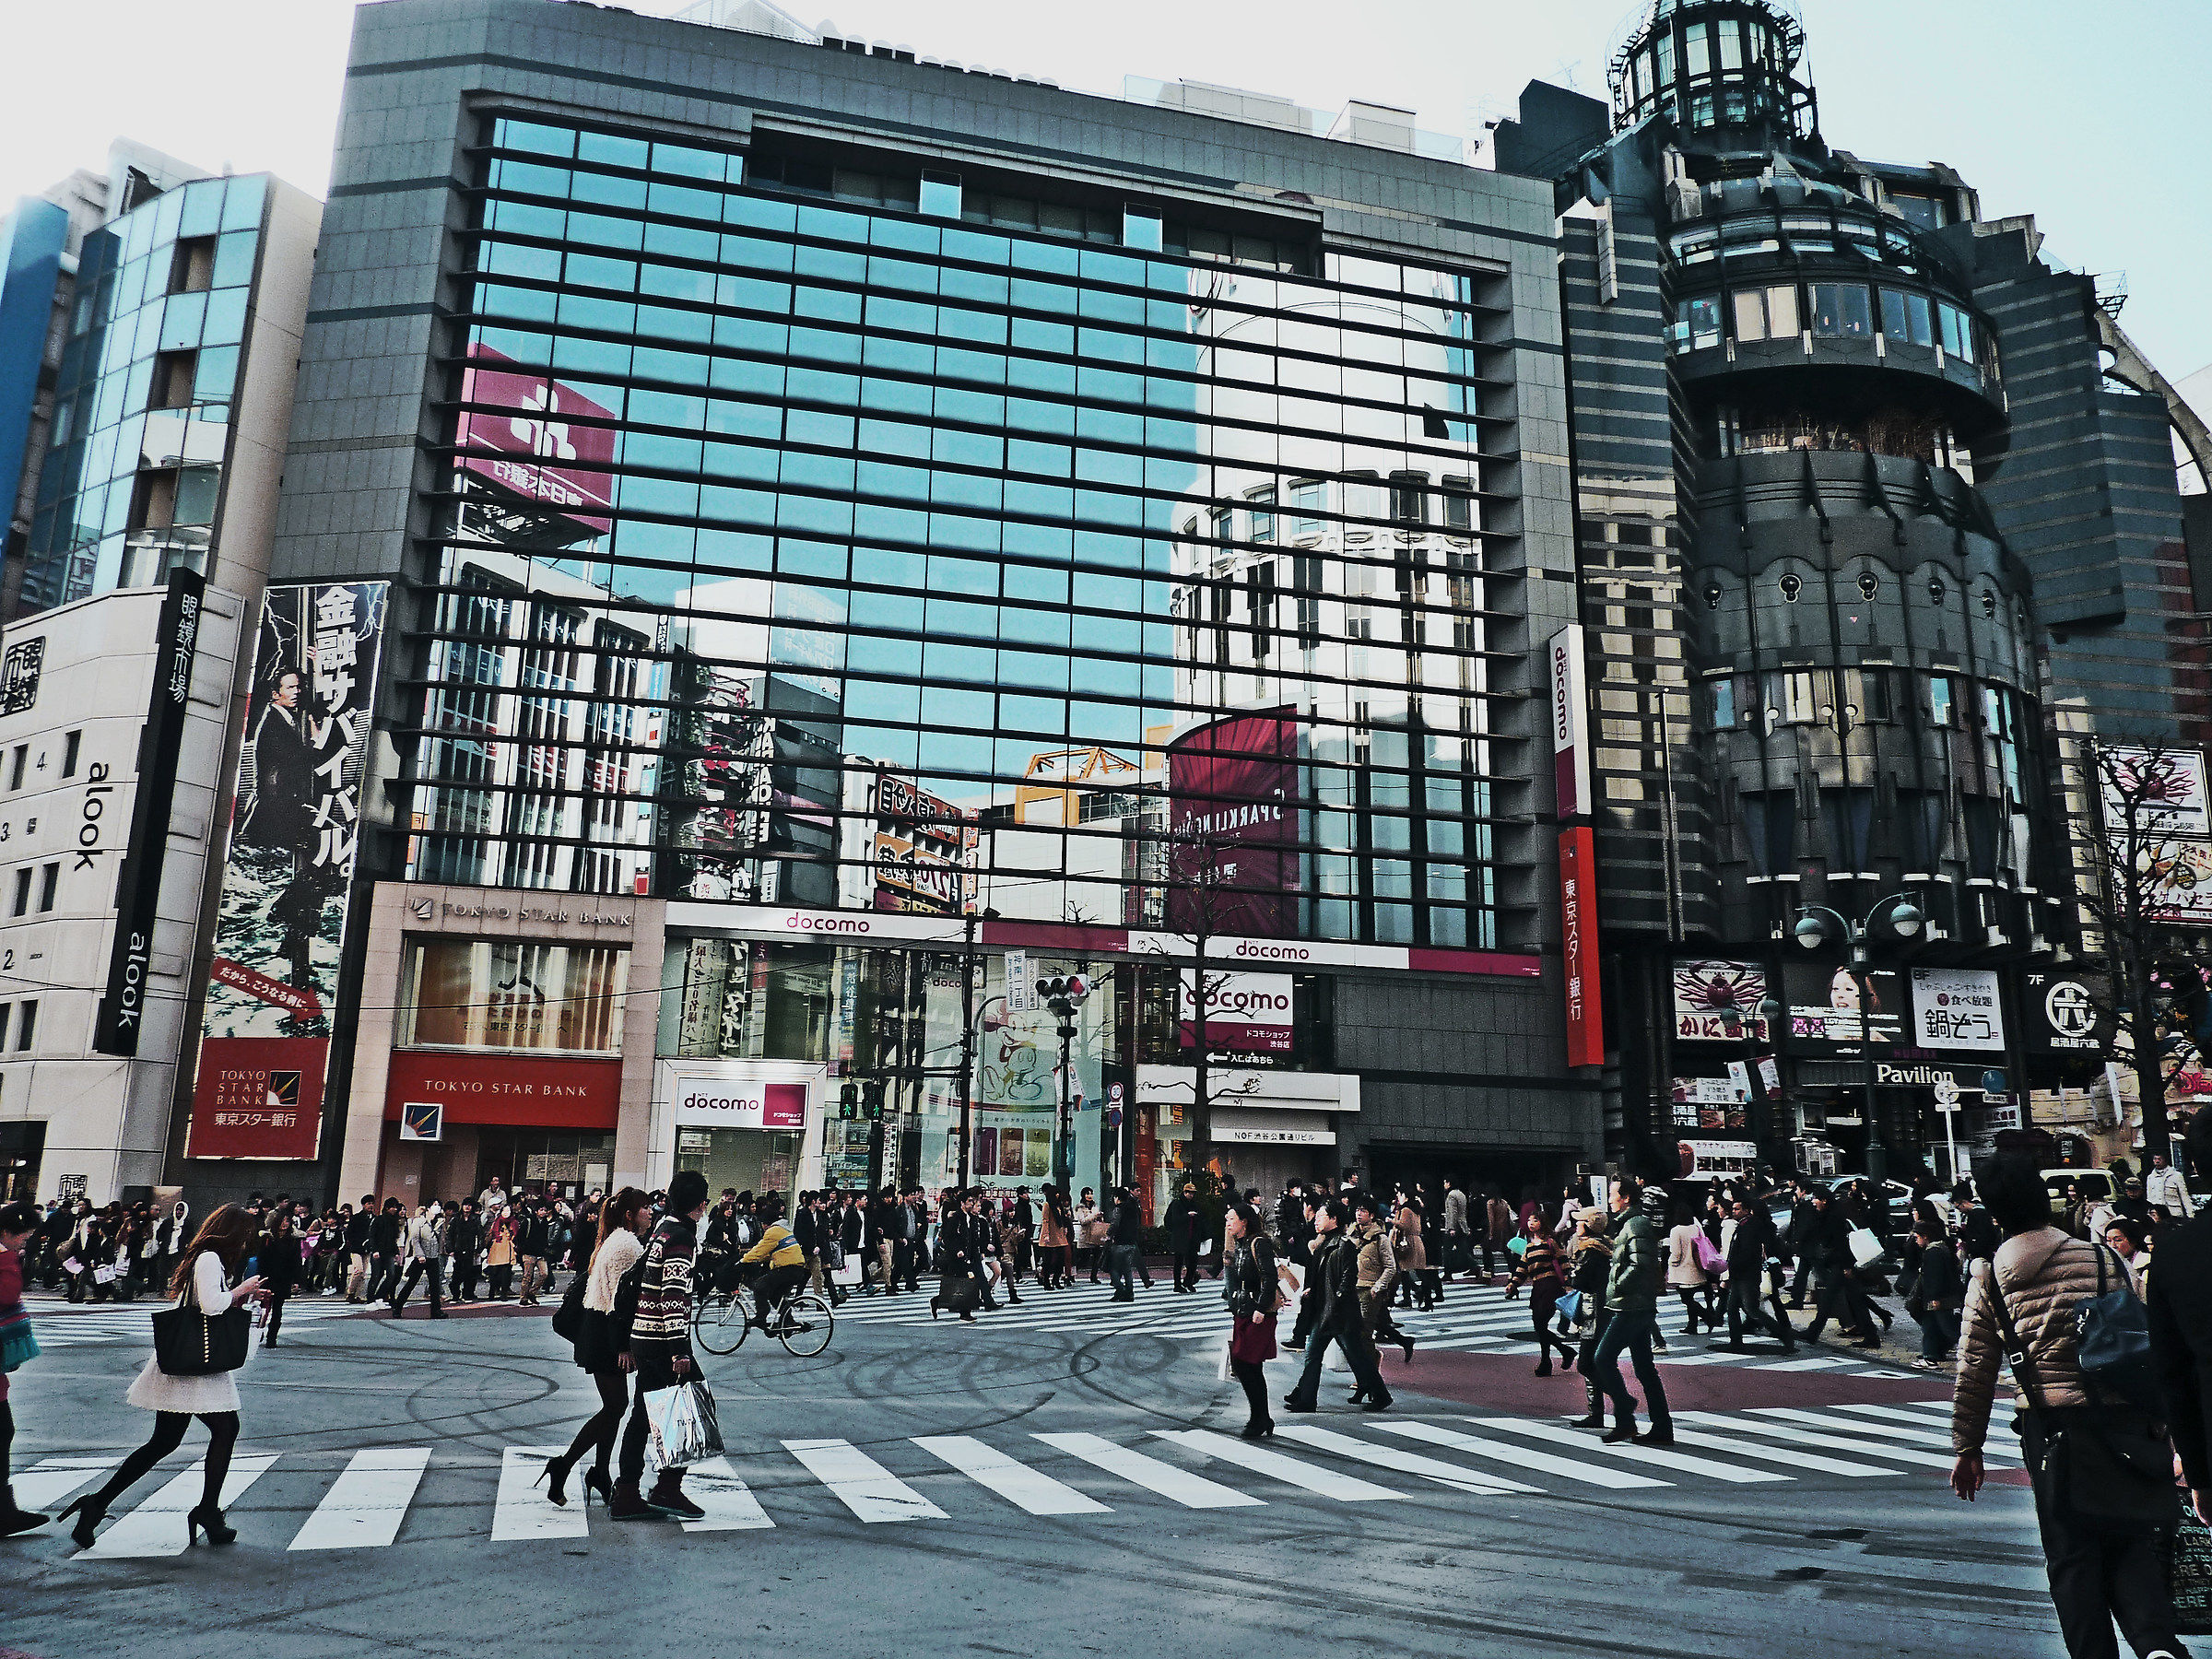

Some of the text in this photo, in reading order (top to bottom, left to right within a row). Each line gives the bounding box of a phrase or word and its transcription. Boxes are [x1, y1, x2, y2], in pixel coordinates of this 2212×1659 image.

[1555, 647, 1568, 740] docomo
[312, 585, 360, 877] 金融サバイバル。
[74, 762, 113, 872] alook
[442, 902, 630, 926] TOKYO STAR BANK
[786, 912, 870, 933] docomo
[1236, 940, 1310, 960] docomo
[1565, 878, 1581, 1020] 東京スター銀行
[118, 932, 147, 1027] alook
[2028, 974, 2044, 985] 7F
[1951, 994, 1994, 1006] 食べ放題
[1246, 1030, 1290, 1039] ドコモショップ
[1270, 1041, 1290, 1049] 渋谷店
[221, 1070, 265, 1080] TOKYO
[1877, 1064, 1954, 1085] Pavilion
[218, 1082, 264, 1093] STAR
[425, 1080, 587, 1097] TOKYO STAR BANK
[217, 1095, 263, 1105] BANK
[684, 1093, 759, 1111] docomo
[214, 1112, 297, 1127] 東京スター銀行
